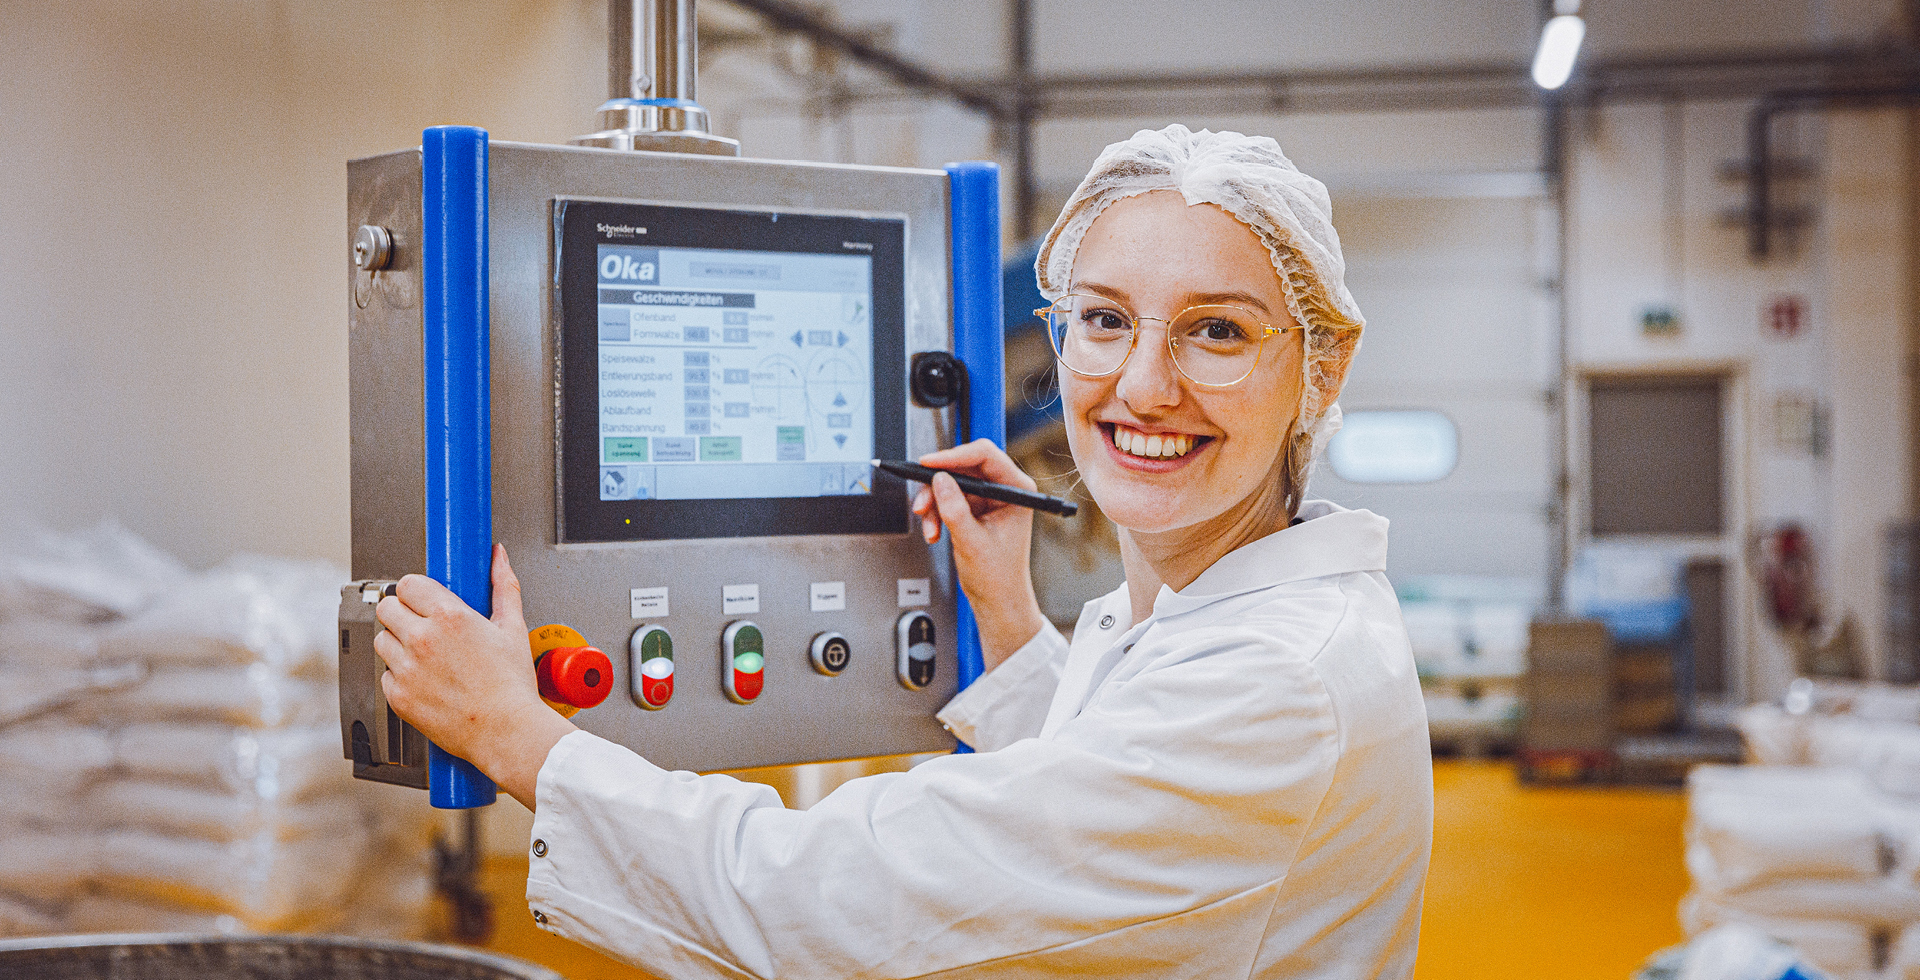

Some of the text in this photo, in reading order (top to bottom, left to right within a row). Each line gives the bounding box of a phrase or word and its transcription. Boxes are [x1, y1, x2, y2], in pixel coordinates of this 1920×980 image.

[597, 223, 635, 238] Schneider
[600, 254, 655, 281] Oka
[633, 291, 724, 306] Geschwindigkeiten
[633, 312, 677, 322] Ofenband
[633, 329, 680, 339] Formwalze
[601, 354, 656, 365] Speisewalze
[601, 371, 673, 382] Entleerungsband
[601, 388, 657, 398] Loslösewelle
[602, 405, 652, 415] Ablaufband
[602, 423, 666, 434] Bandspannung
